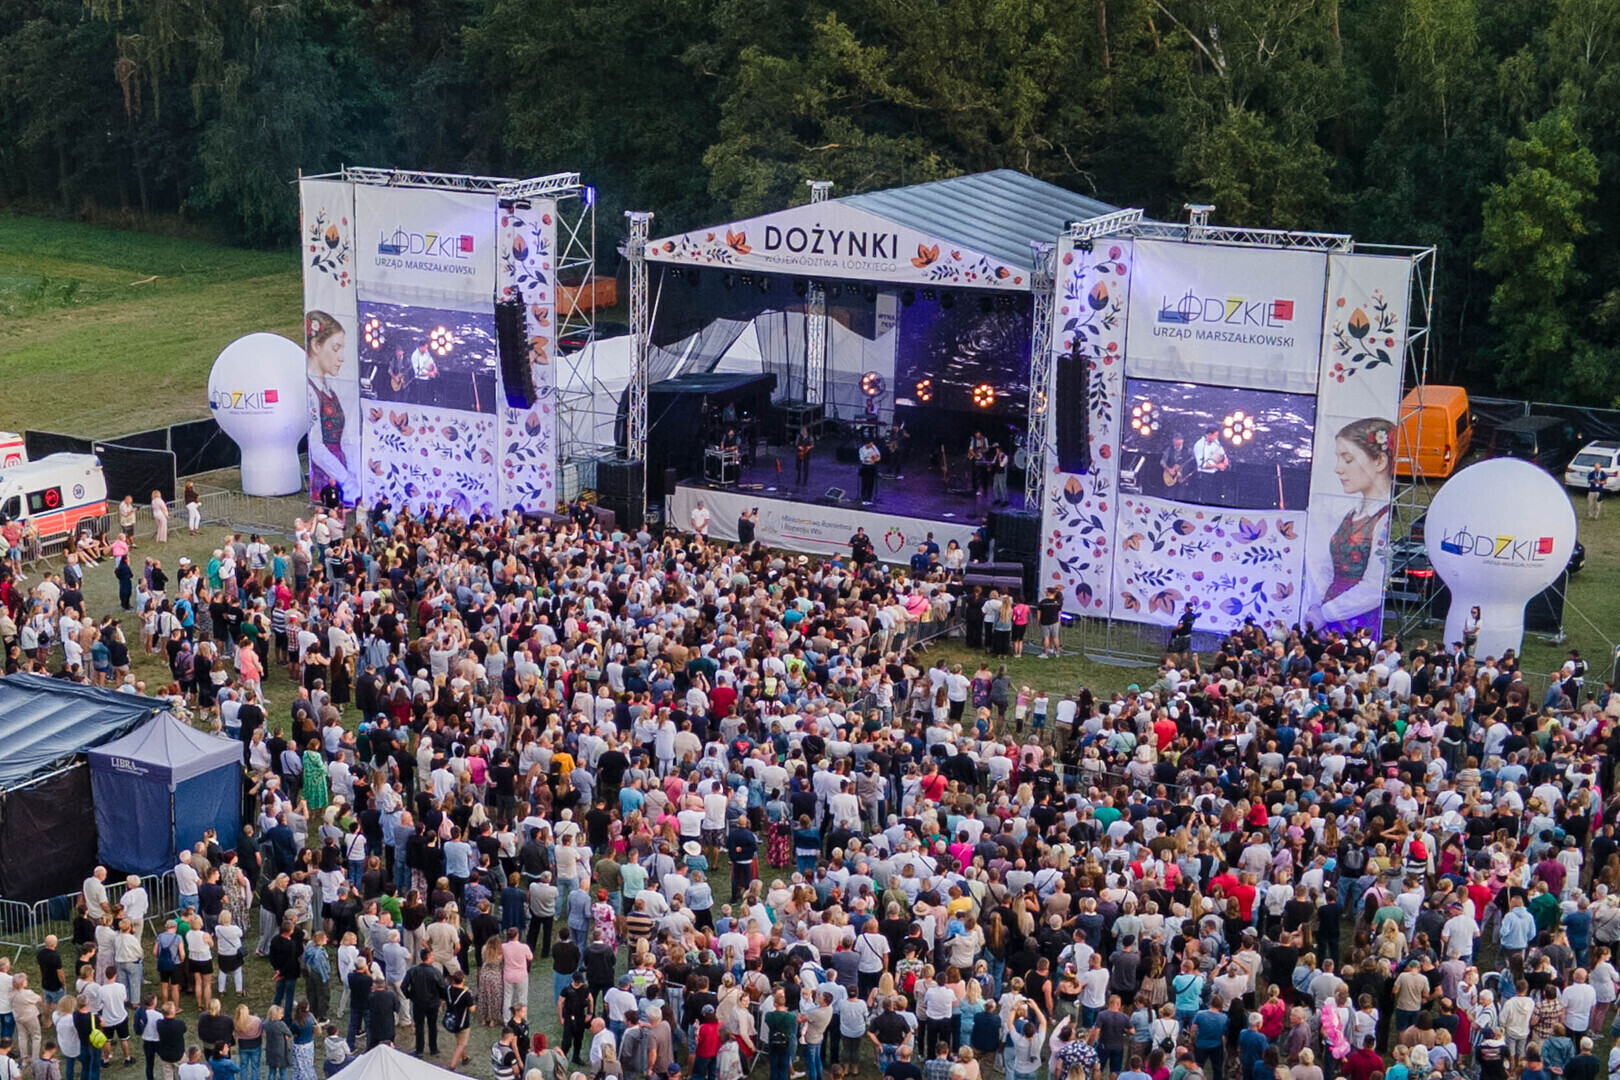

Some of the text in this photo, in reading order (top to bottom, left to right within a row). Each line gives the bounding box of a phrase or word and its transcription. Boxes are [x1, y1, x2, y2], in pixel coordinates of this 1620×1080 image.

[765, 223, 898, 259] DOŻYNKI
[375, 257, 476, 276] URZĄD MARSZAŁKOWSKI
[1153, 326, 1294, 348] URZĄD MARSZAŁKOWSKI
[111, 757, 136, 770] LIBRA
